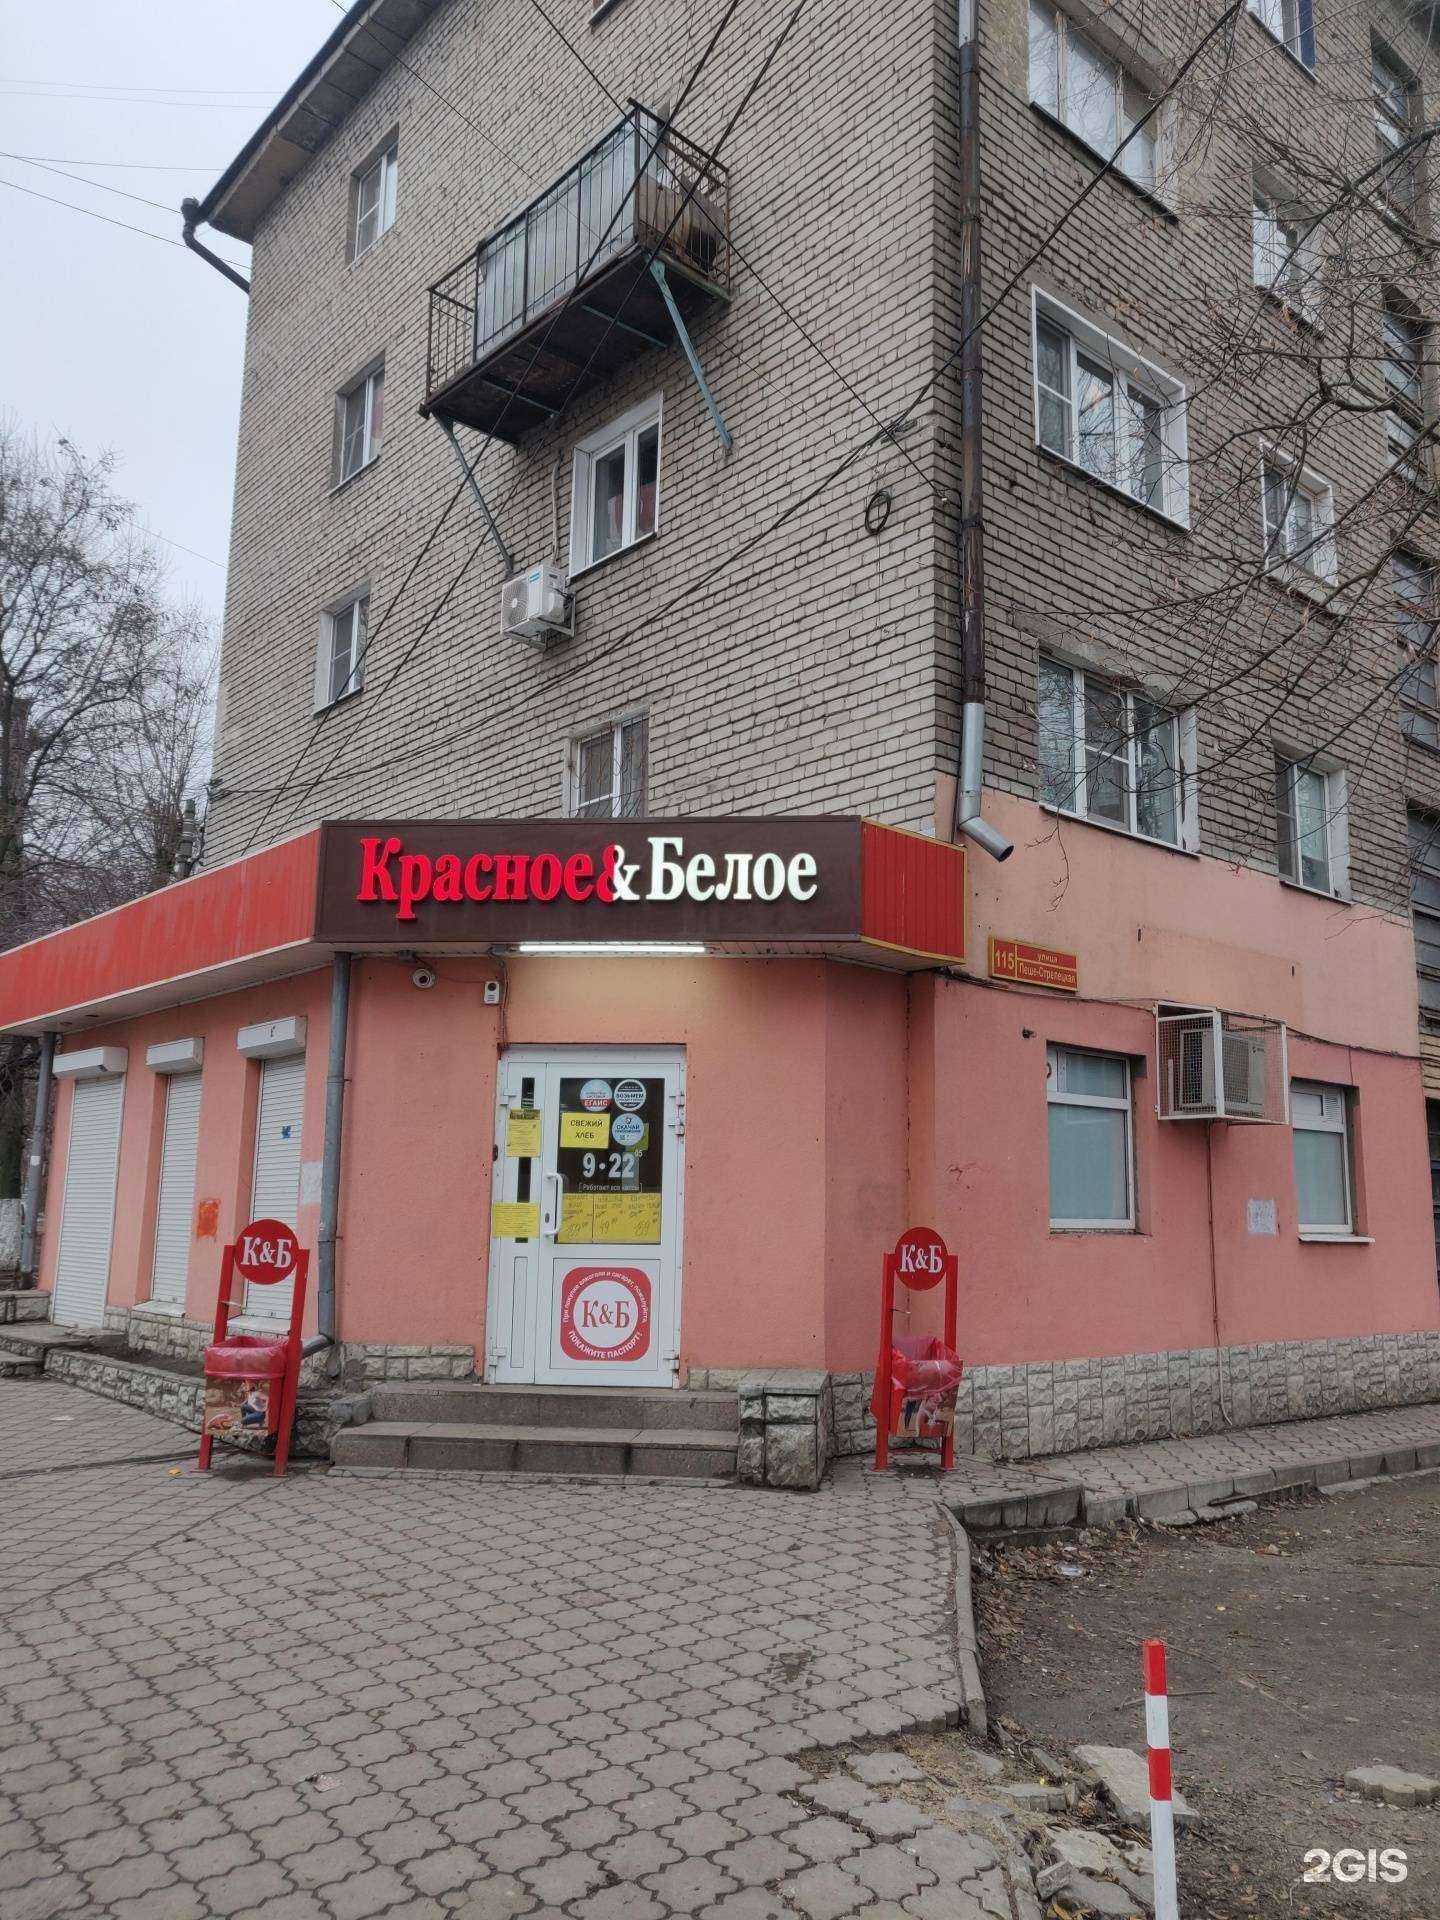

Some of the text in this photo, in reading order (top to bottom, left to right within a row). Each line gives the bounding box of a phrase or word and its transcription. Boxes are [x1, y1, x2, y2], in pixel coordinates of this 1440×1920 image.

[995, 949, 1015, 970] 115
[1036, 953, 1058, 963] улица
[1019, 961, 1076, 983] Пеше-Стрелецкая
[570, 1119, 603, 1128] СВЕЖИЙ
[575, 1131, 595, 1139] ХЛЕБ
[240, 1236, 292, 1269] К&Б
[900, 1244, 943, 1274] К&Б
[581, 1300, 630, 1328] К&Б
[568, 1330, 606, 1359] ПОКАЖИТЕ
